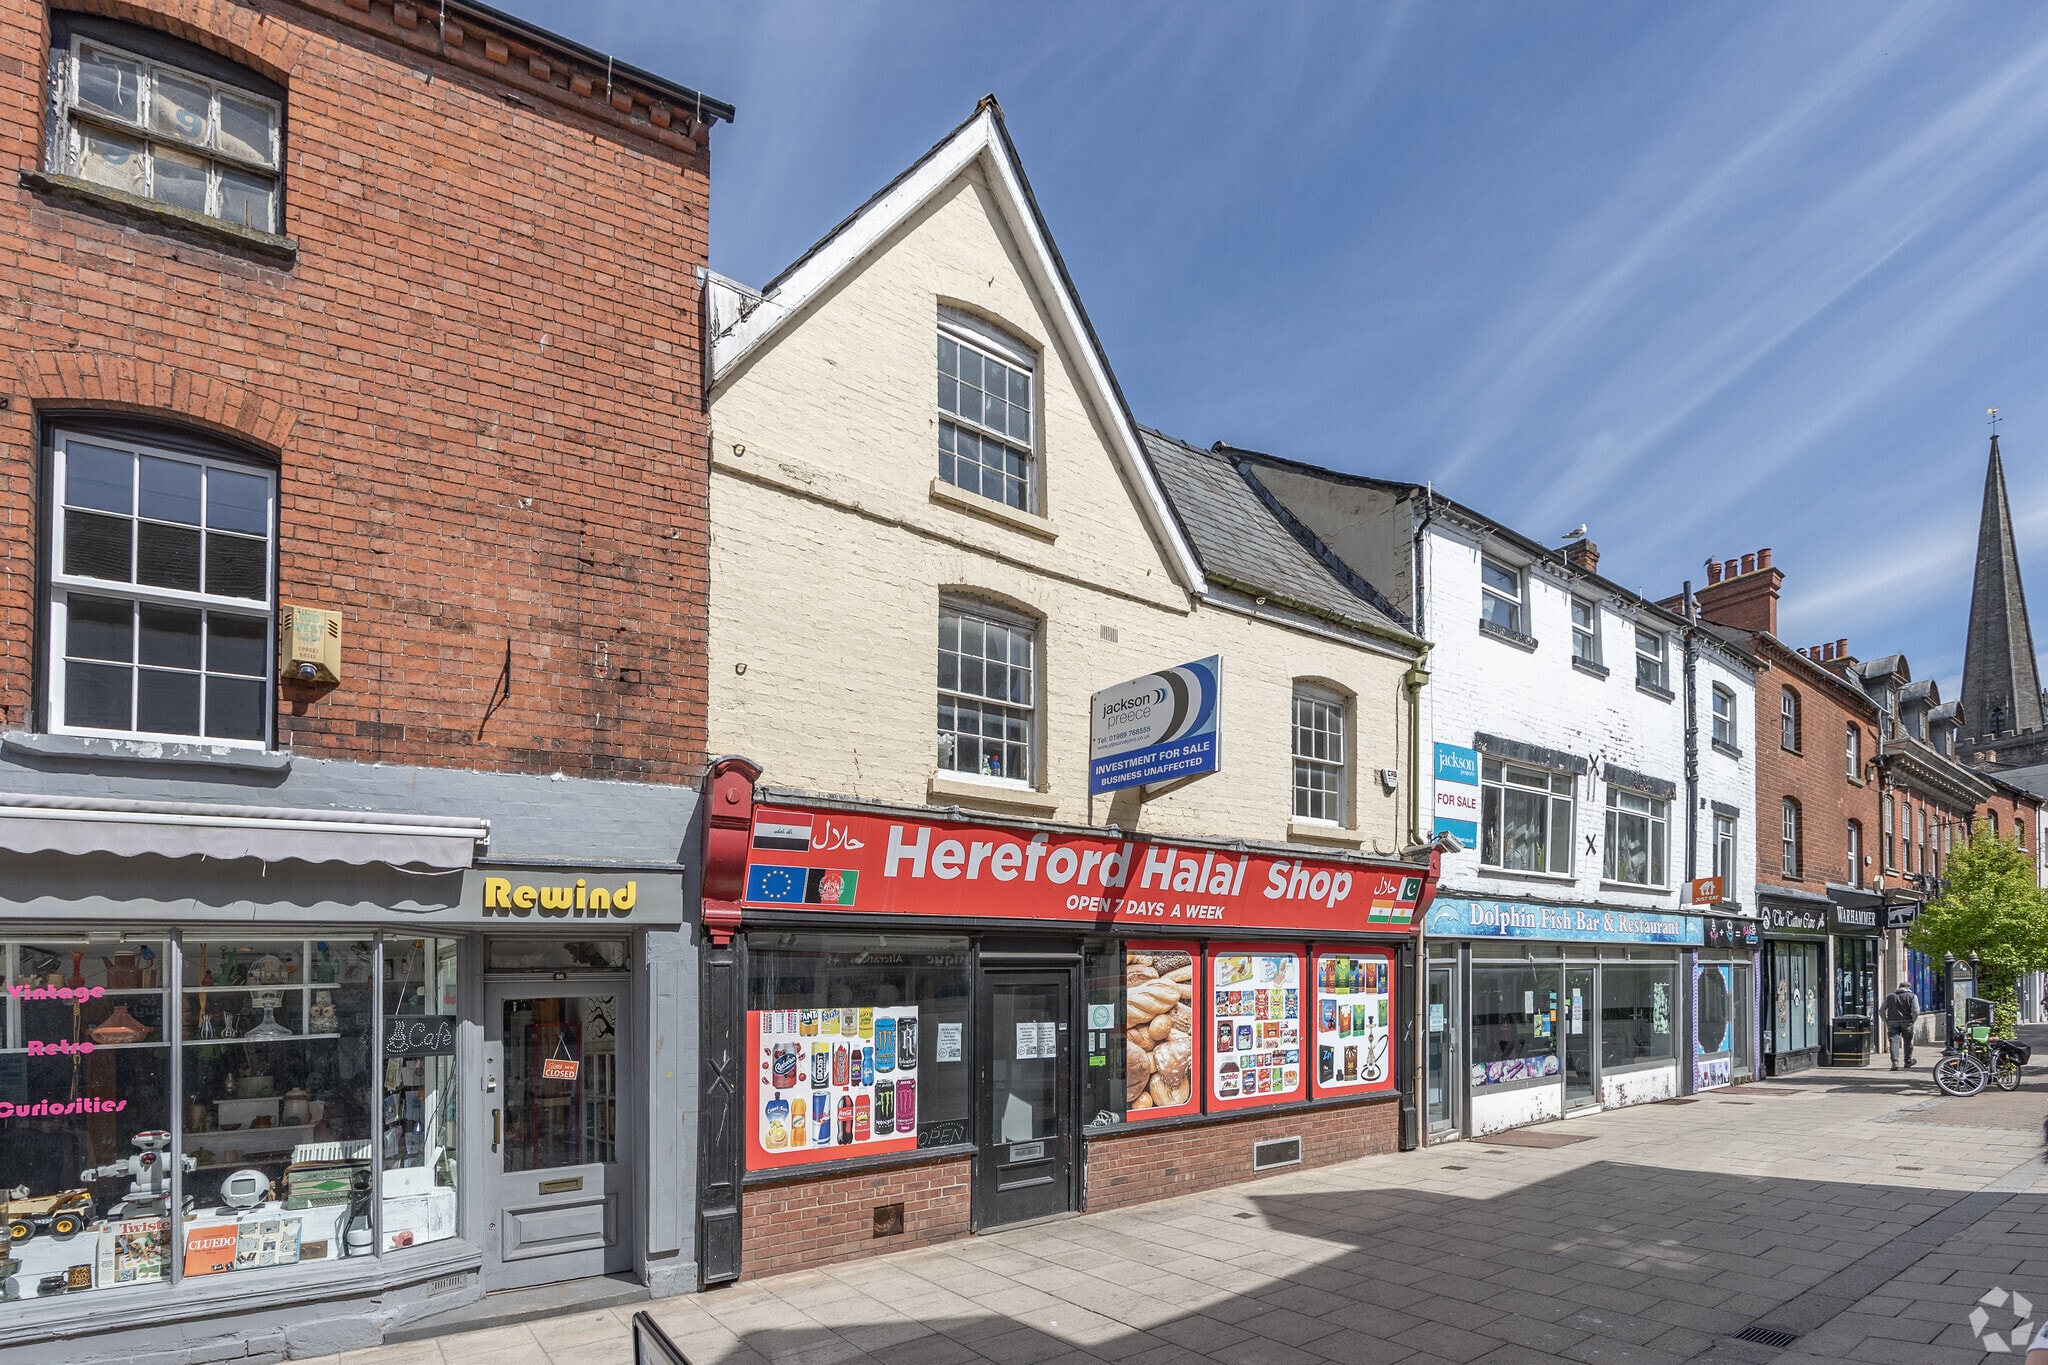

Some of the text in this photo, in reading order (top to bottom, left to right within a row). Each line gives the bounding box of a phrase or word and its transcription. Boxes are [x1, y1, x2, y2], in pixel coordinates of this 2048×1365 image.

[1102, 693, 1150, 719] jackson
[1107, 705, 1151, 730] preece
[1095, 741, 1210, 775] INVESTMENT FOR SALE
[1439, 749, 1475, 772] jackson
[1101, 757, 1203, 786] BUSINESS UNAFFECTED
[1437, 793, 1476, 810] FOR SALE
[812, 819, 865, 851] حلال
[884, 825, 1353, 909] Hereford Halal Shop
[485, 877, 637, 910] Rewind
[1066, 894, 1225, 920] OPEN 7 DAYS A WEEK
[1469, 902, 1680, 936] Dolphin Fish Bar & Restaurant
[1837, 905, 1876, 926] WARHAMMER
[7, 984, 106, 1003] Vintage
[27, 1039, 95, 1056] Retro
[545, 1069, 575, 1079] CLOSED
[816, 1054, 824, 1080] BOOST
[0, 1096, 128, 1119] Curiosities
[188, 1236, 236, 1251] CLUEDO
